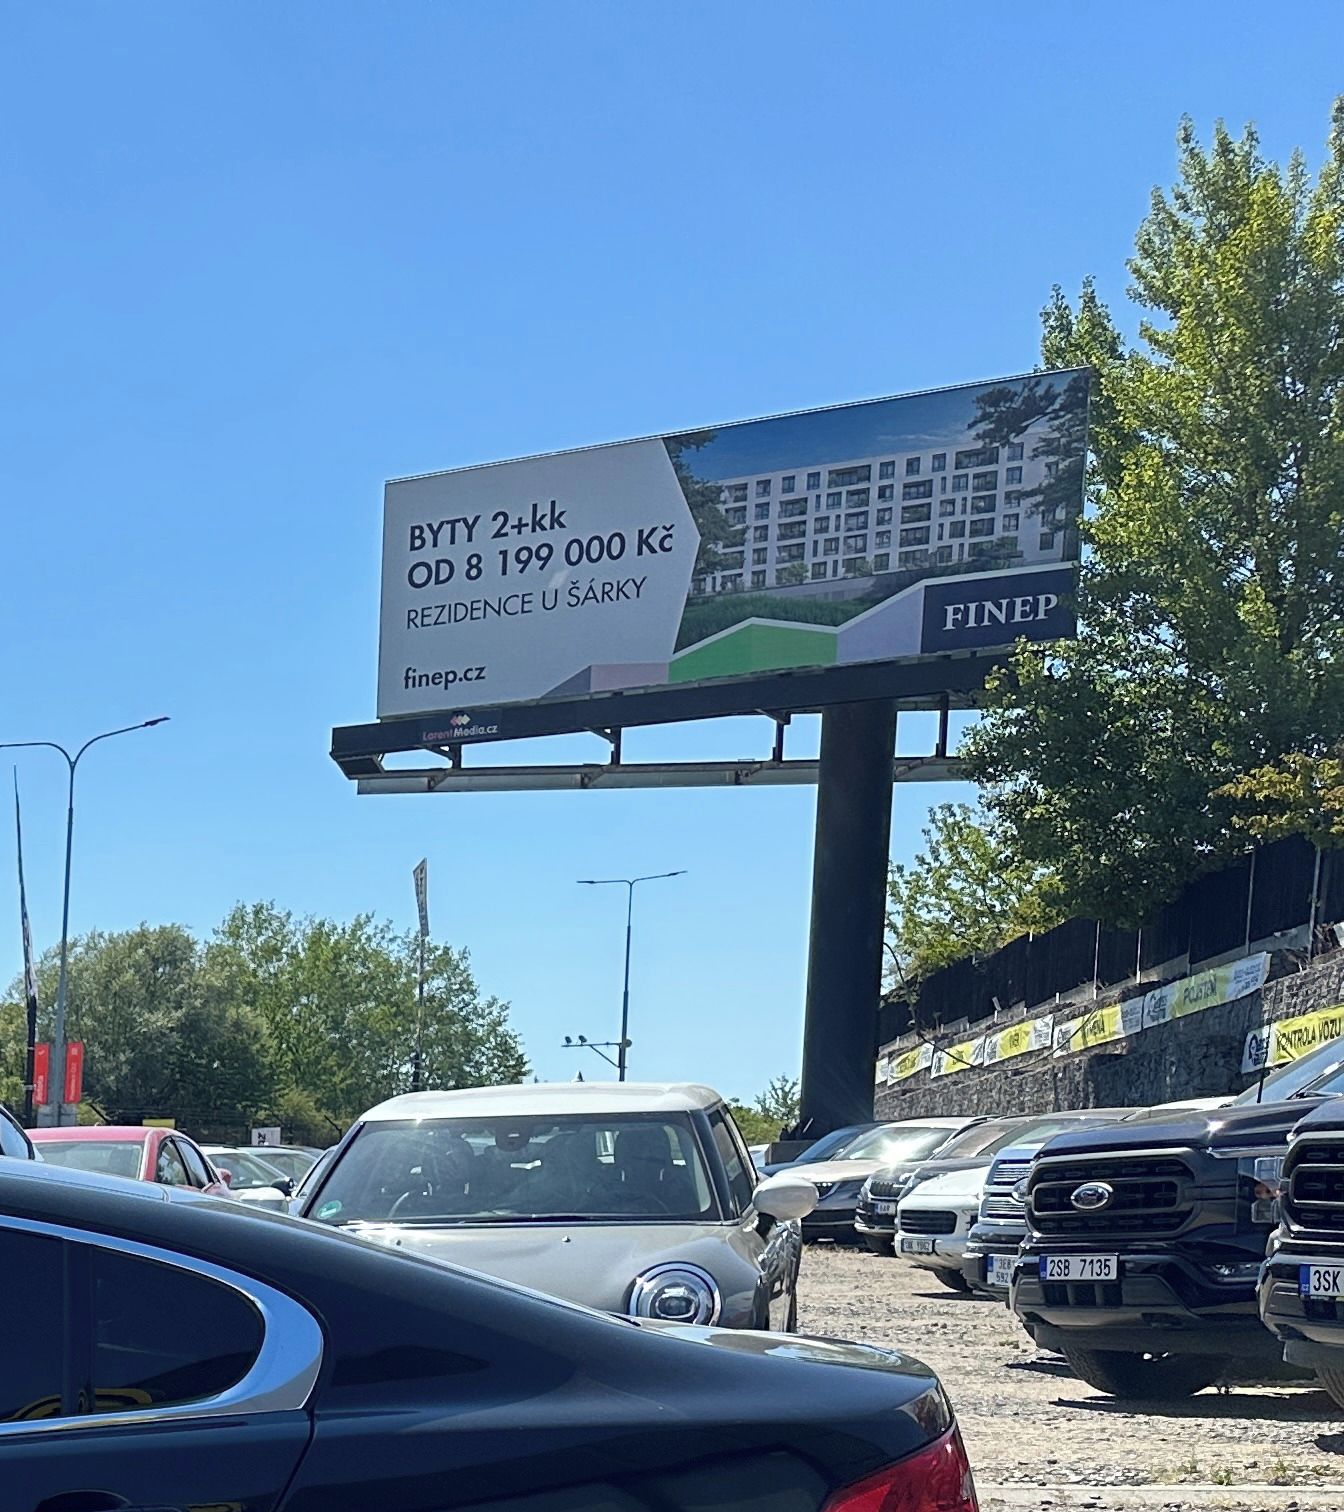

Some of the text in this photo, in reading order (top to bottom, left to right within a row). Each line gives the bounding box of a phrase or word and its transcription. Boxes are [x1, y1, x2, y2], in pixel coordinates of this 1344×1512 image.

[408, 500, 568, 552] BYTY 2+kk
[407, 523, 676, 589] OD 8 199 000 Kč
[406, 576, 648, 630] REZIDENCE U ŠÁRKY
[942, 593, 1058, 630] FINEP
[403, 665, 487, 691] finep.cz
[1048, 1258, 1112, 1278] 2SB 7135
[1312, 1269, 1341, 1293] 3SK
